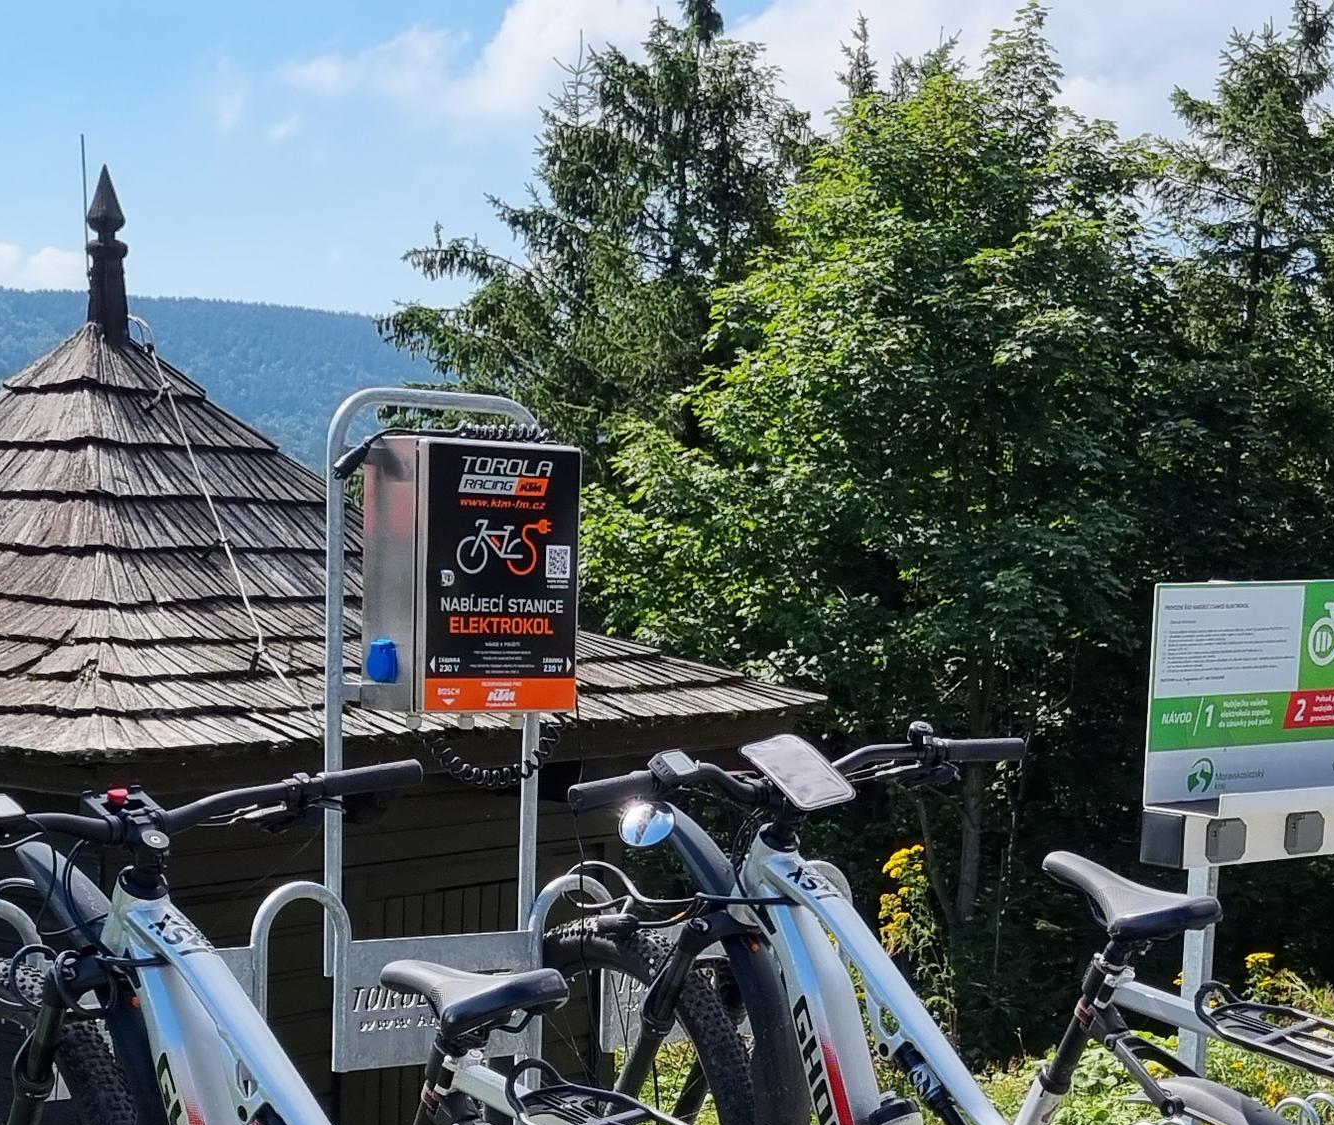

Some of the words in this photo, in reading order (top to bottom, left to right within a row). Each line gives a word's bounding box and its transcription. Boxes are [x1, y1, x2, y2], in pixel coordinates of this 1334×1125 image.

[462, 456, 553, 477] TOROLA
[464, 479, 514, 491] RACING
[520, 482, 542, 492] KTM
[460, 499, 546, 510] www.ktm-fm.cz
[440, 593, 504, 612] NABÍJECÍ
[508, 599, 564, 614] STANICE
[449, 616, 554, 635] ELEKTROKOL
[439, 664, 452, 672] 230
[438, 687, 460, 696] BOSCH
[487, 688, 516, 701] KTM
[1161, 710, 1193, 725] NÁVOD
[1205, 704, 1215, 728] 1
[1293, 698, 1307, 722] 2
